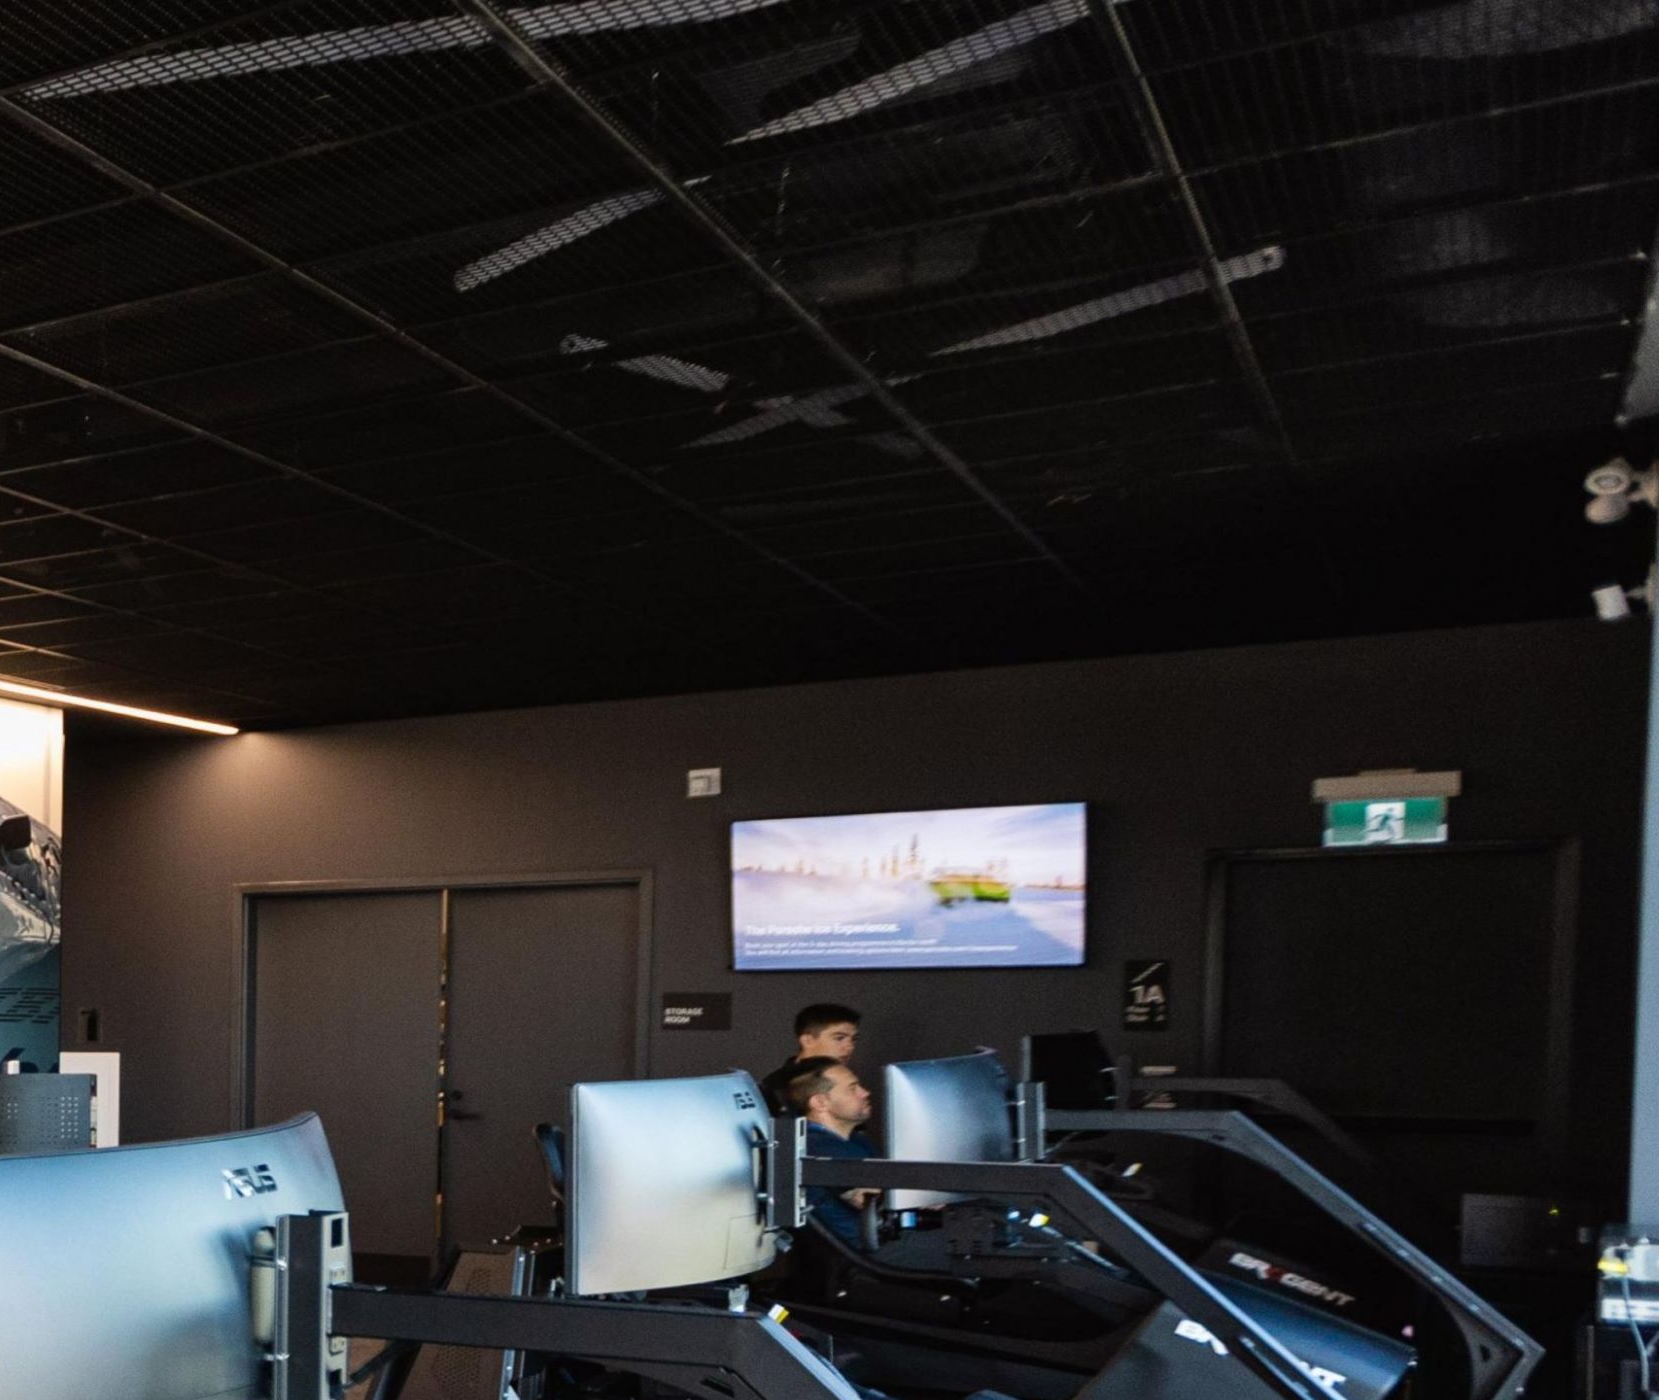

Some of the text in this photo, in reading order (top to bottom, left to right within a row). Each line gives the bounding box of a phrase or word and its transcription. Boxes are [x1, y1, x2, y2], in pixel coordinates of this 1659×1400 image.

[1129, 985, 1165, 1003] 1A
[664, 1007, 704, 1016] STORAGE
[664, 1016, 691, 1024] ROOM
